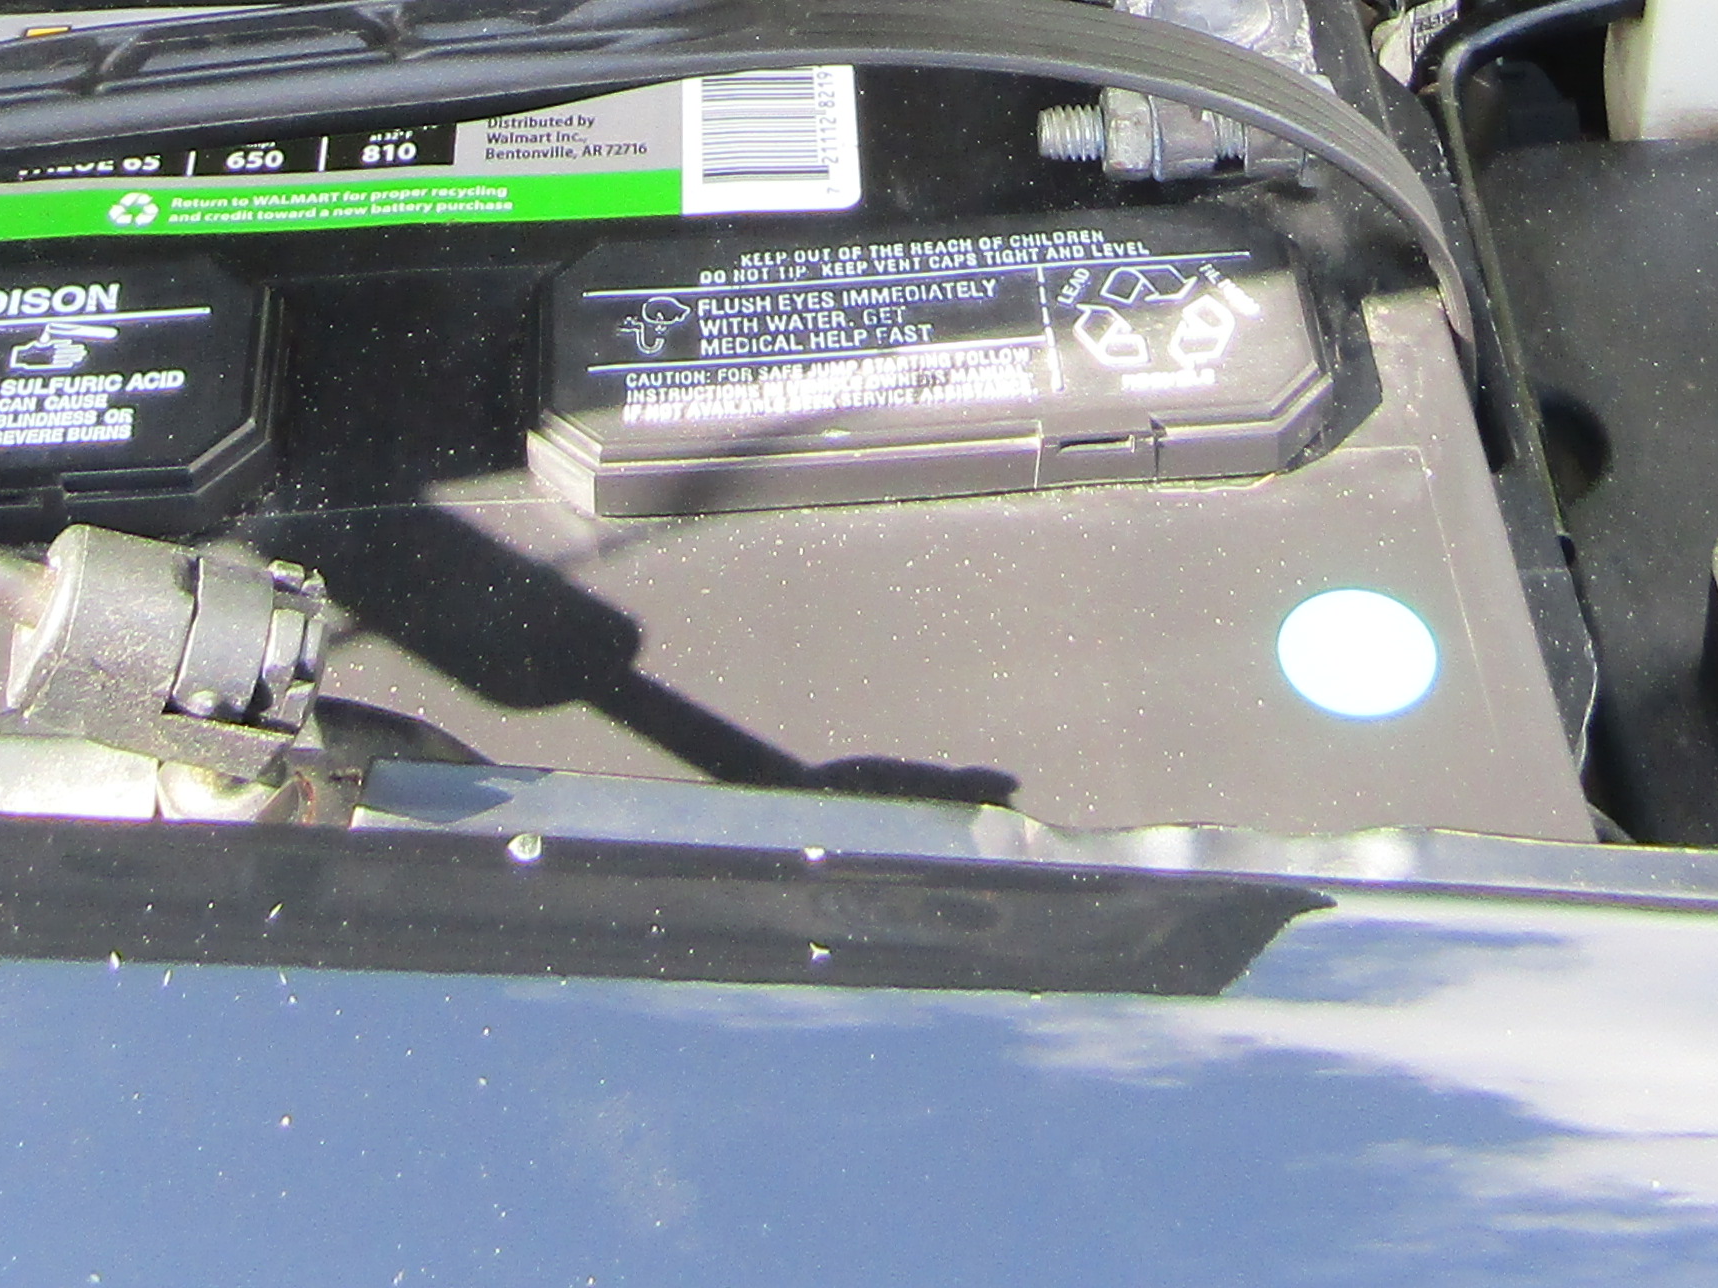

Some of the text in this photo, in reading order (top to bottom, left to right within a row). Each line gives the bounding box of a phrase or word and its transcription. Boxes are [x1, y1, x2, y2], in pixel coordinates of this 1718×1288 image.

[487, 114, 596, 130] Distributed by
[486, 130, 553, 145] Walmart
[225, 148, 285, 170] 650
[360, 141, 418, 163] 810
[485, 142, 648, 161] Bentonville, AR 72716
[171, 184, 509, 209] Return to WALMART for proper recycling
[168, 199, 514, 224] and credit toward a new battery purchase
[794, 248, 832, 264] OUT
[838, 245, 863, 261] OF
[869, 242, 904, 259] THE
[910, 237, 973, 257] REACH
[978, 236, 1003, 252] OF
[1009, 229, 1105, 248] CHILDREN
[699, 270, 727, 285] DO
[733, 267, 770, 284] NOT
[821, 260, 868, 277] KEEP
[873, 257, 921, 274] VENT
[928, 252, 978, 270] CAPS
[985, 247, 1039, 266] TIGHT
[1045, 244, 1085, 261] AND
[1091, 240, 1151, 258] LEVEL
[697, 278, 998, 318] FLUSH EYES IMMEDIATELY
[1056, 267, 1092, 306] LEAD
[700, 305, 907, 338] WITH WATER. GET
[700, 323, 934, 357] MEDICAL HELP FAST
[625, 346, 1031, 389] CAUTION: FOR SAFE JUMP STARTING FOLLOW
[0, 369, 186, 398] SULFURIC ACID
[626, 381, 760, 405] INSTRUCTIONS
[43, 392, 110, 411] CAUSE
[103, 407, 135, 425] OR
[66, 424, 133, 444] BURNS
